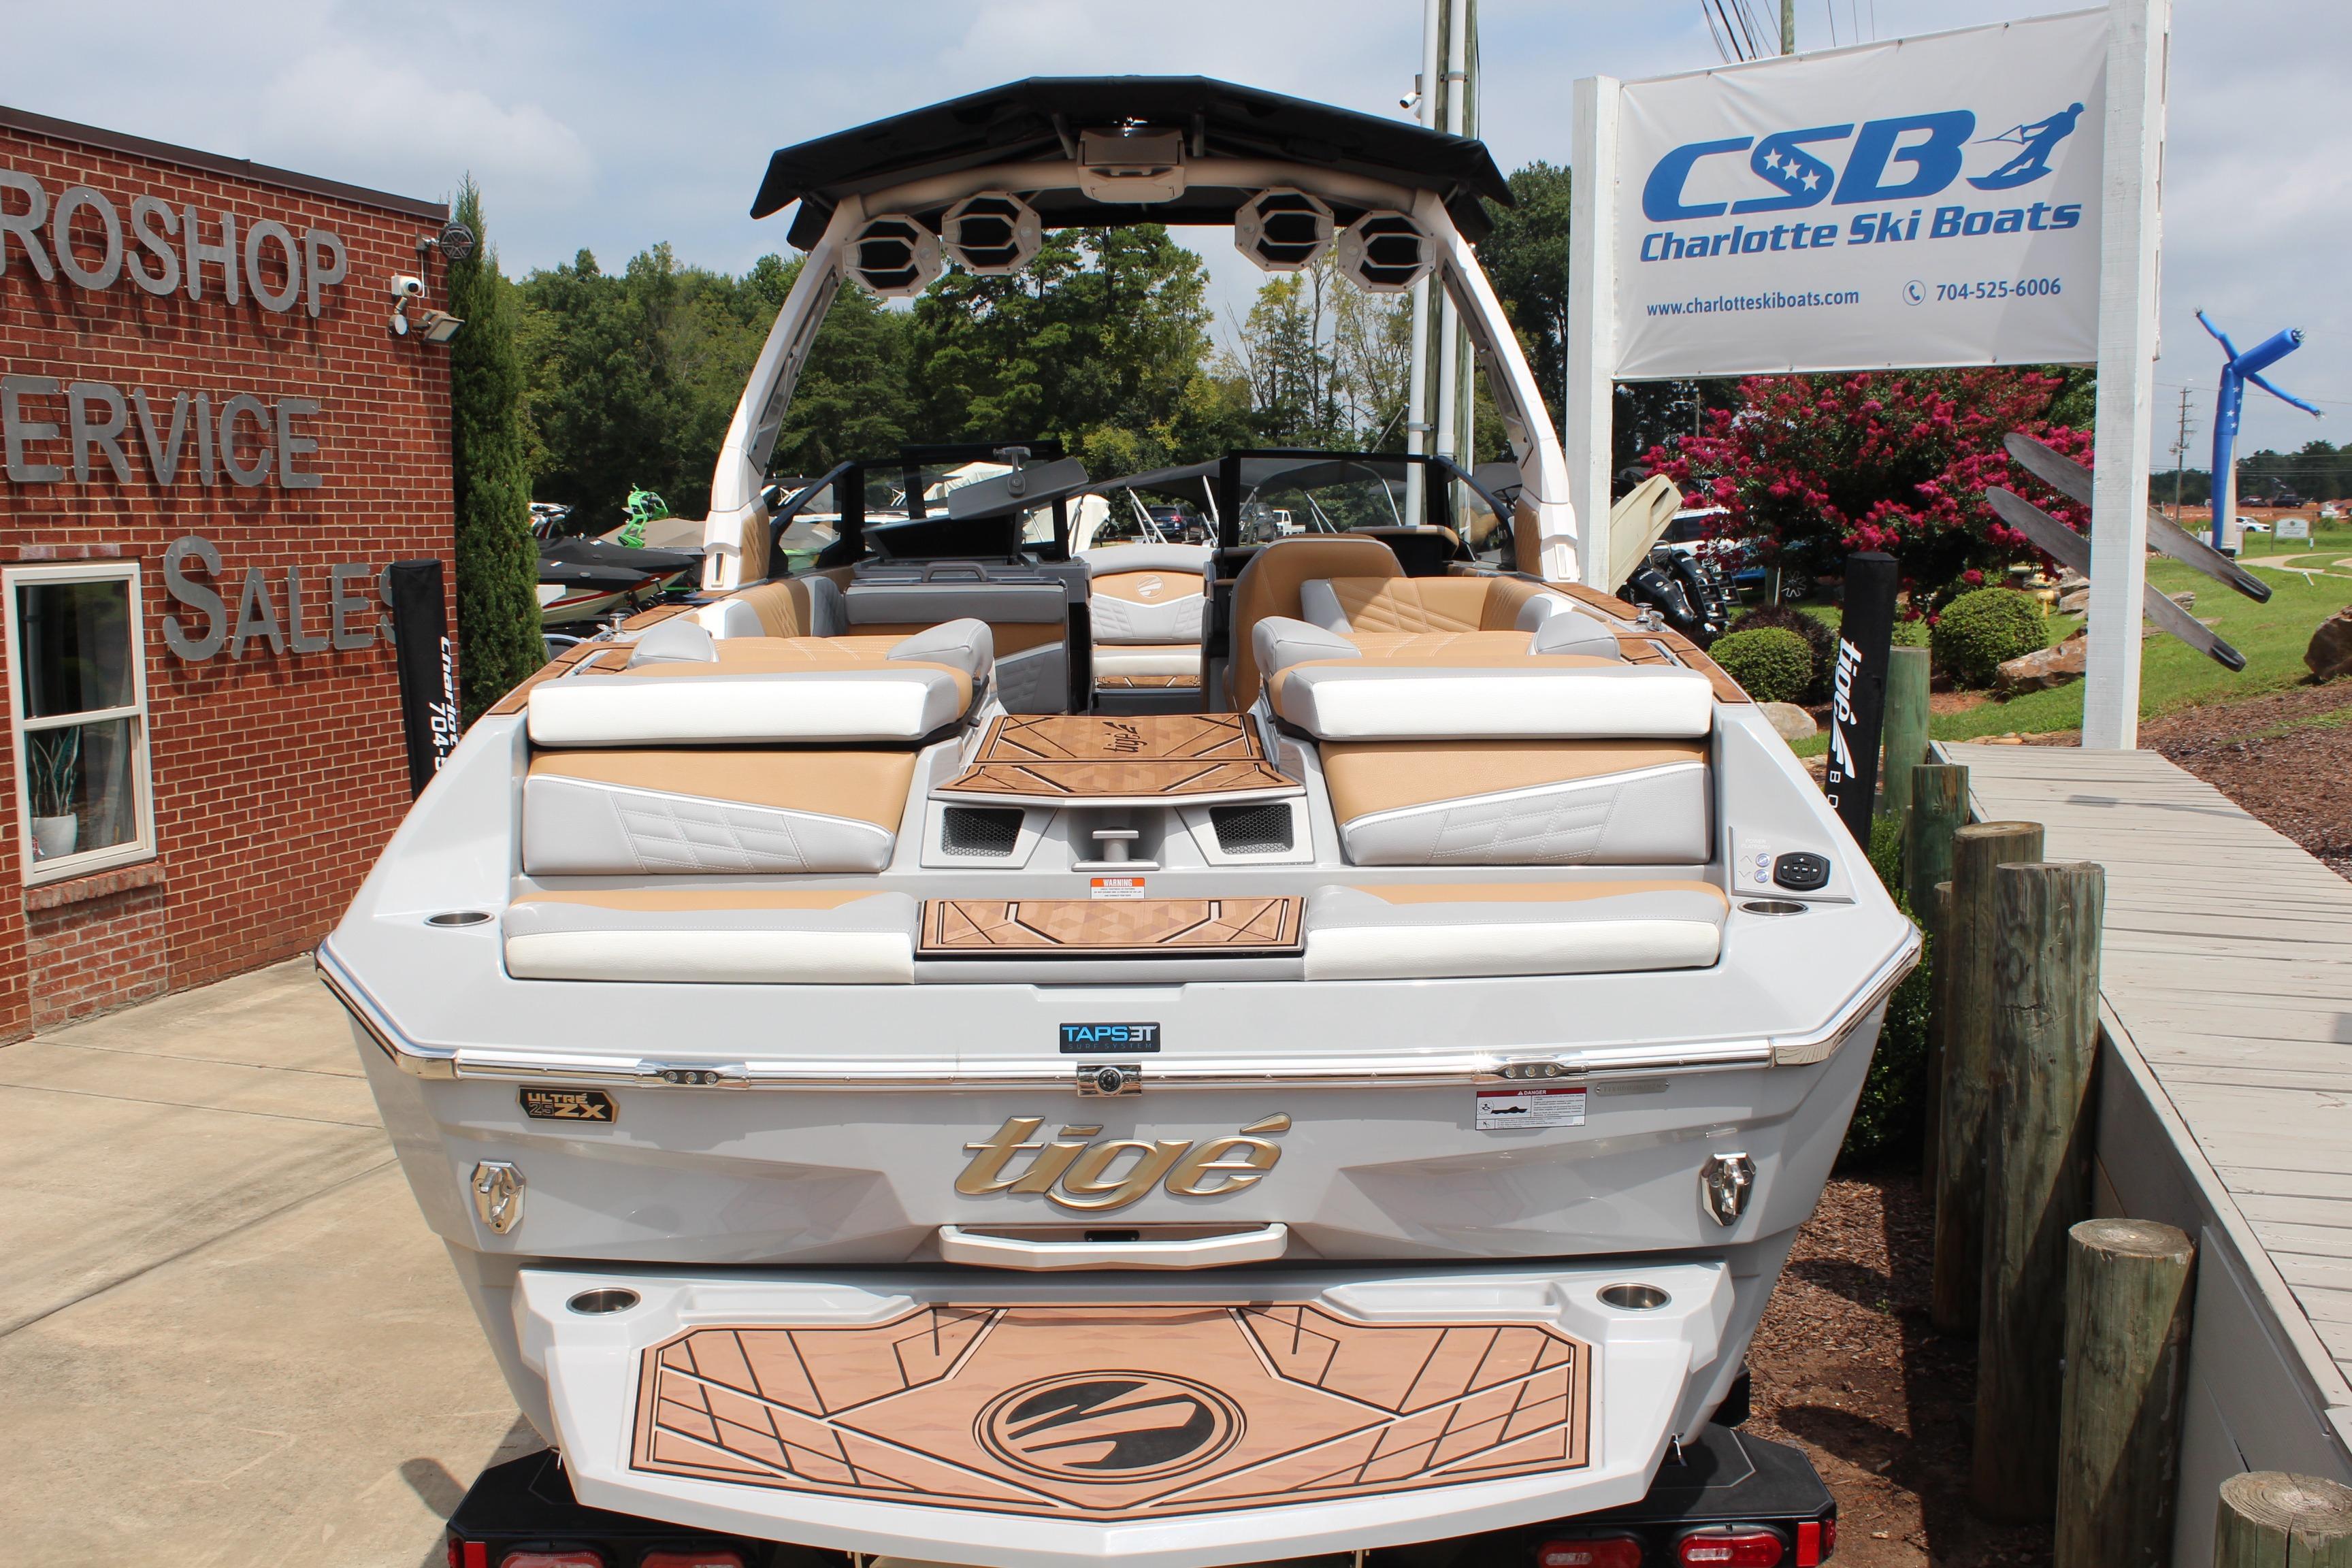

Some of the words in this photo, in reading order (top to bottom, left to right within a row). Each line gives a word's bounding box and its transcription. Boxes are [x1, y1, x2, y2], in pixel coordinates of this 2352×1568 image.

[1642, 110, 1976, 222] CSB
[0, 170, 347, 317] ROSHOP
[1640, 223, 1838, 262] Charlotte
[1847, 209, 1923, 245] Ski
[1928, 201, 2082, 239] Boats
[1647, 291, 1859, 316] www.charlotteskiboats.com
[1936, 278, 2061, 301] 704-525-6006
[1, 375, 322, 489] ERVICE
[1102, 879, 1133, 887] WARNING
[953, 1111, 1292, 1211] tigé
